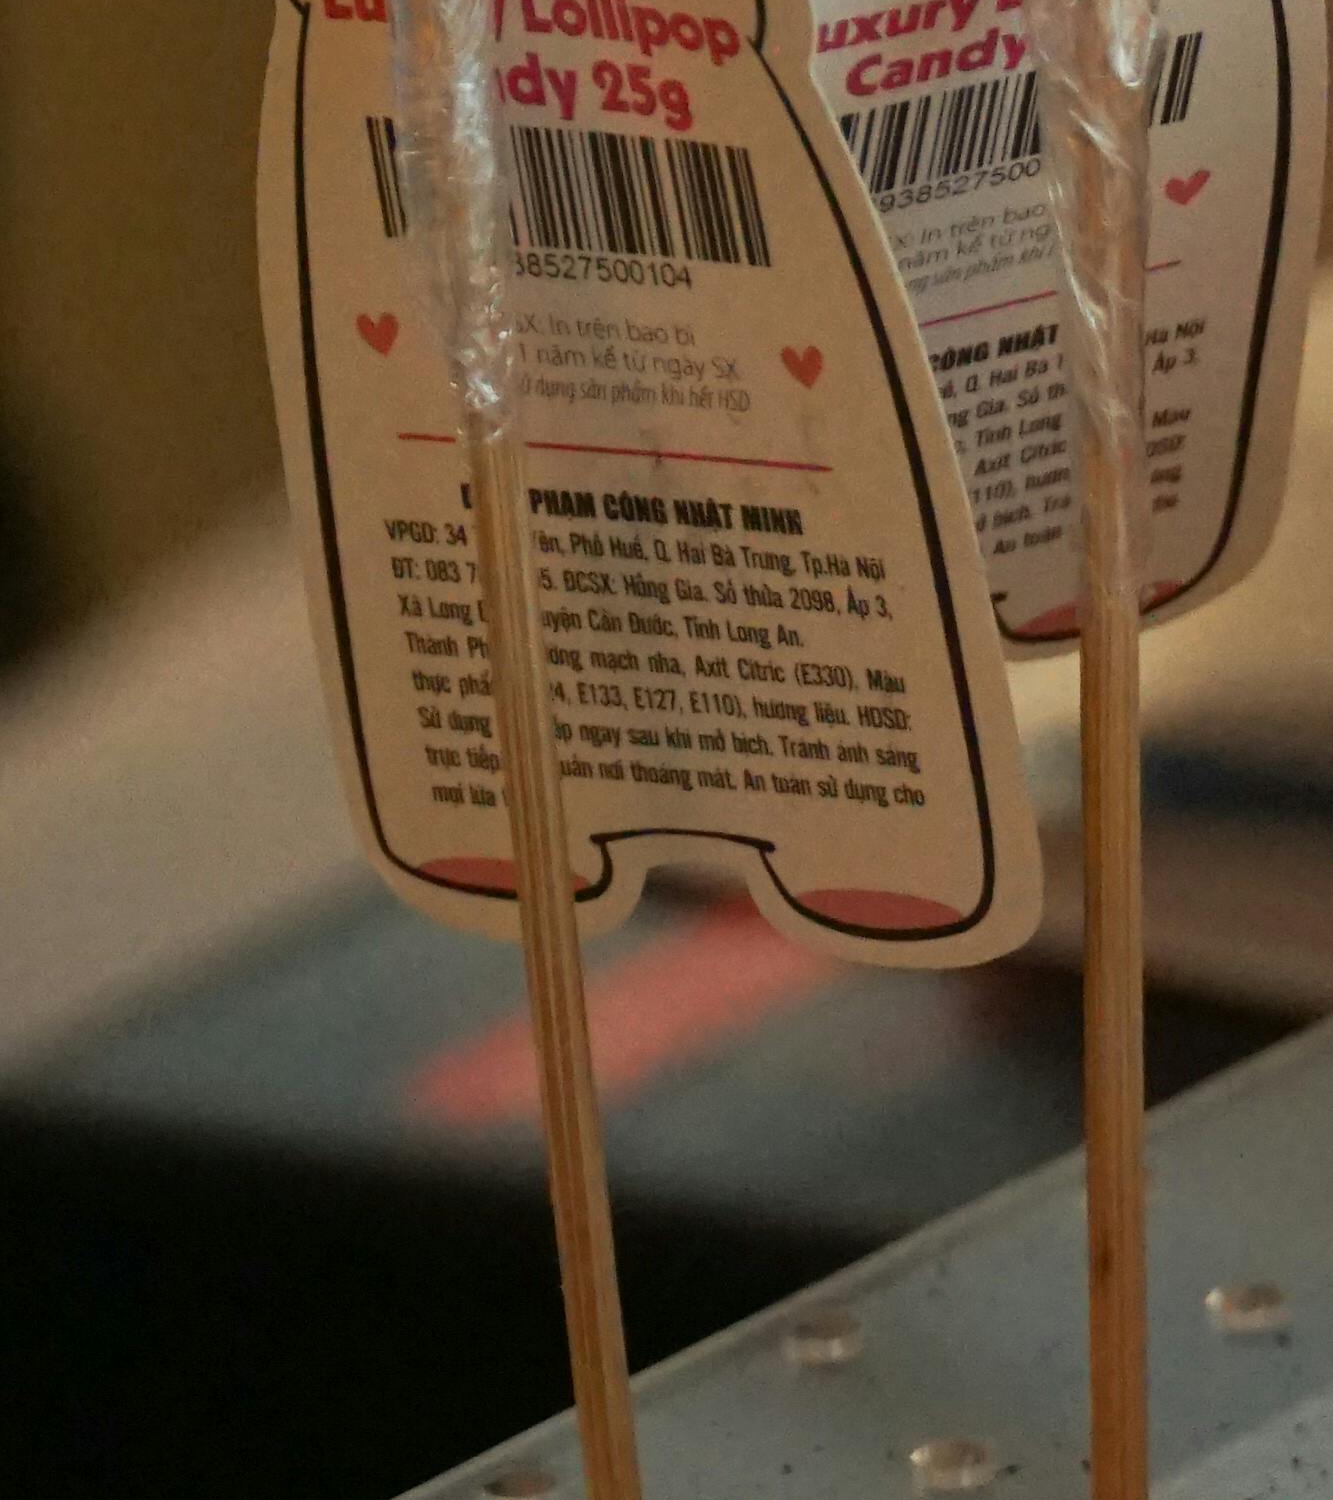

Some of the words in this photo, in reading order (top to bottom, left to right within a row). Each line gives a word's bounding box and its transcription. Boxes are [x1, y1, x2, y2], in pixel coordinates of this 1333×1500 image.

[591, 60, 694, 132] 25g
[602, 489, 669, 525] CÔNG
[739, 503, 804, 536] MINH
[677, 538, 706, 565] Hai
[710, 541, 736, 567] Bà
[855, 555, 886, 582] Nội
[427, 596, 474, 627] Long
[726, 618, 772, 649] Long
[694, 655, 731, 679] Axit
[736, 657, 786, 683] Citric
[626, 727, 660, 747] sau
[743, 768, 767, 793] An
[892, 782, 927, 807] cho
